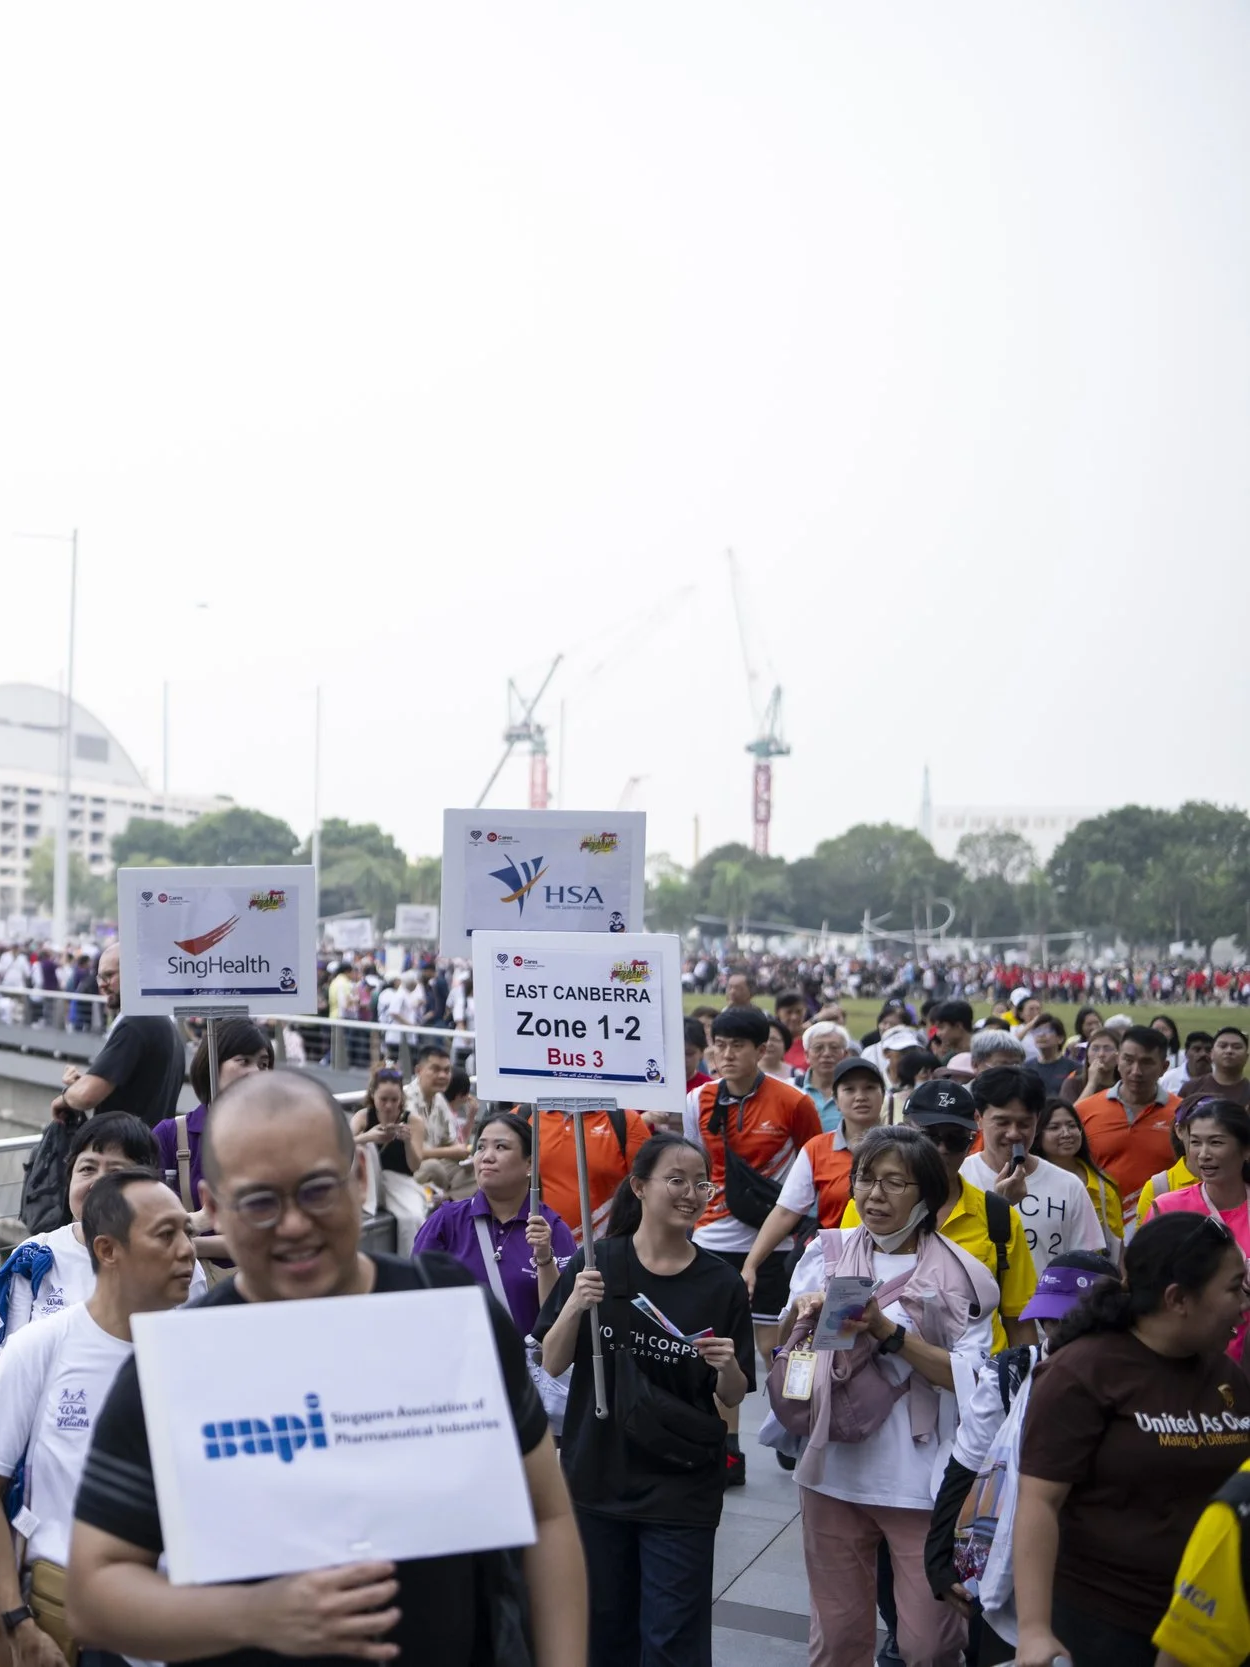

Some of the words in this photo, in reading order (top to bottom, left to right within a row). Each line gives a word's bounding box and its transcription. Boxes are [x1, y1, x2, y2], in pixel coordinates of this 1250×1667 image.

[543, 885, 604, 904] HSA
[167, 955, 270, 979] SingHealth
[505, 983, 549, 999] EAST
[553, 985, 651, 1003] CANBERRA
[516, 1011, 587, 1039] Zone
[597, 1014, 641, 1041] 1-2
[547, 1047, 586, 1066] Bus
[593, 1050, 604, 1068] 3
[609, 1343, 679, 1364] SGAPORE
[648, 1335, 699, 1358] CORPS
[58, 1405, 87, 1415] Walk
[331, 1409, 394, 1427] Singapore
[397, 1401, 468, 1419] Association
[472, 1397, 486, 1411] of
[57, 1416, 89, 1428] Health
[334, 1423, 433, 1445] Pharmaceutical
[437, 1417, 500, 1434] Industries
[1134, 1410, 1198, 1433] United
[1199, 1412, 1223, 1433] As
[1158, 1434, 1198, 1449] Making
